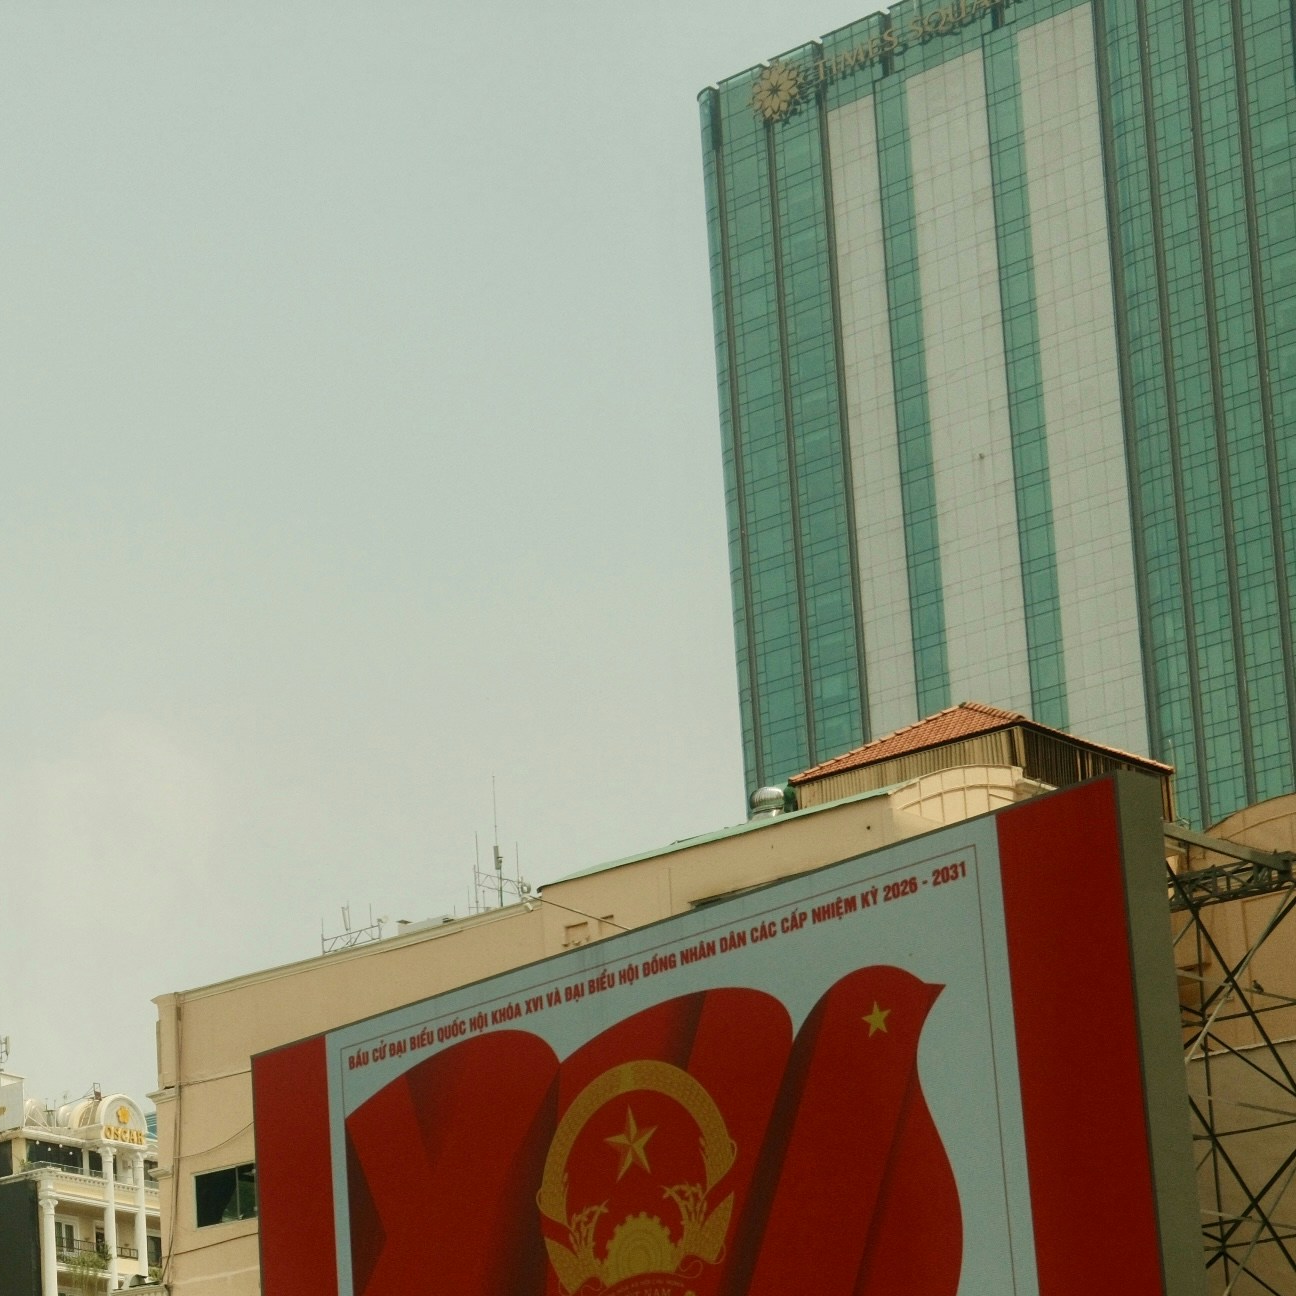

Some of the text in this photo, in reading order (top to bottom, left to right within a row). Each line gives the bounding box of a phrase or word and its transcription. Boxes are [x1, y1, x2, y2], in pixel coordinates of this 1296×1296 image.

[815, 28, 899, 80] TIMES
[348, 1049, 369, 1070] BẦU
[372, 1039, 388, 1062] CỬ
[389, 1039, 406, 1059] ĐẠI
[409, 1026, 434, 1051] BIỂU
[437, 1017, 467, 1043] QUỐC
[469, 1011, 489, 1033] HỘI
[491, 1002, 522, 1025] KHÓA
[525, 994, 543, 1015] XVI
[546, 987, 562, 1008] VÀ
[564, 983, 585, 1003] ĐẠI
[588, 968, 616, 995] BIỂU
[619, 963, 639, 986] HỘI
[642, 952, 677, 978] ĐỒNG
[680, 940, 717, 966] NHÂN
[719, 931, 747, 954] DÂN
[750, 920, 777, 943] CÁC
[781, 907, 808, 934] CẤP
[811, 895, 857, 924] NHIỆM
[860, 885, 879, 910] KỲ
[883, 876, 918, 902] 2026
[932, 861, 967, 887] 2031
[104, 1125, 145, 1146] OSCAR
